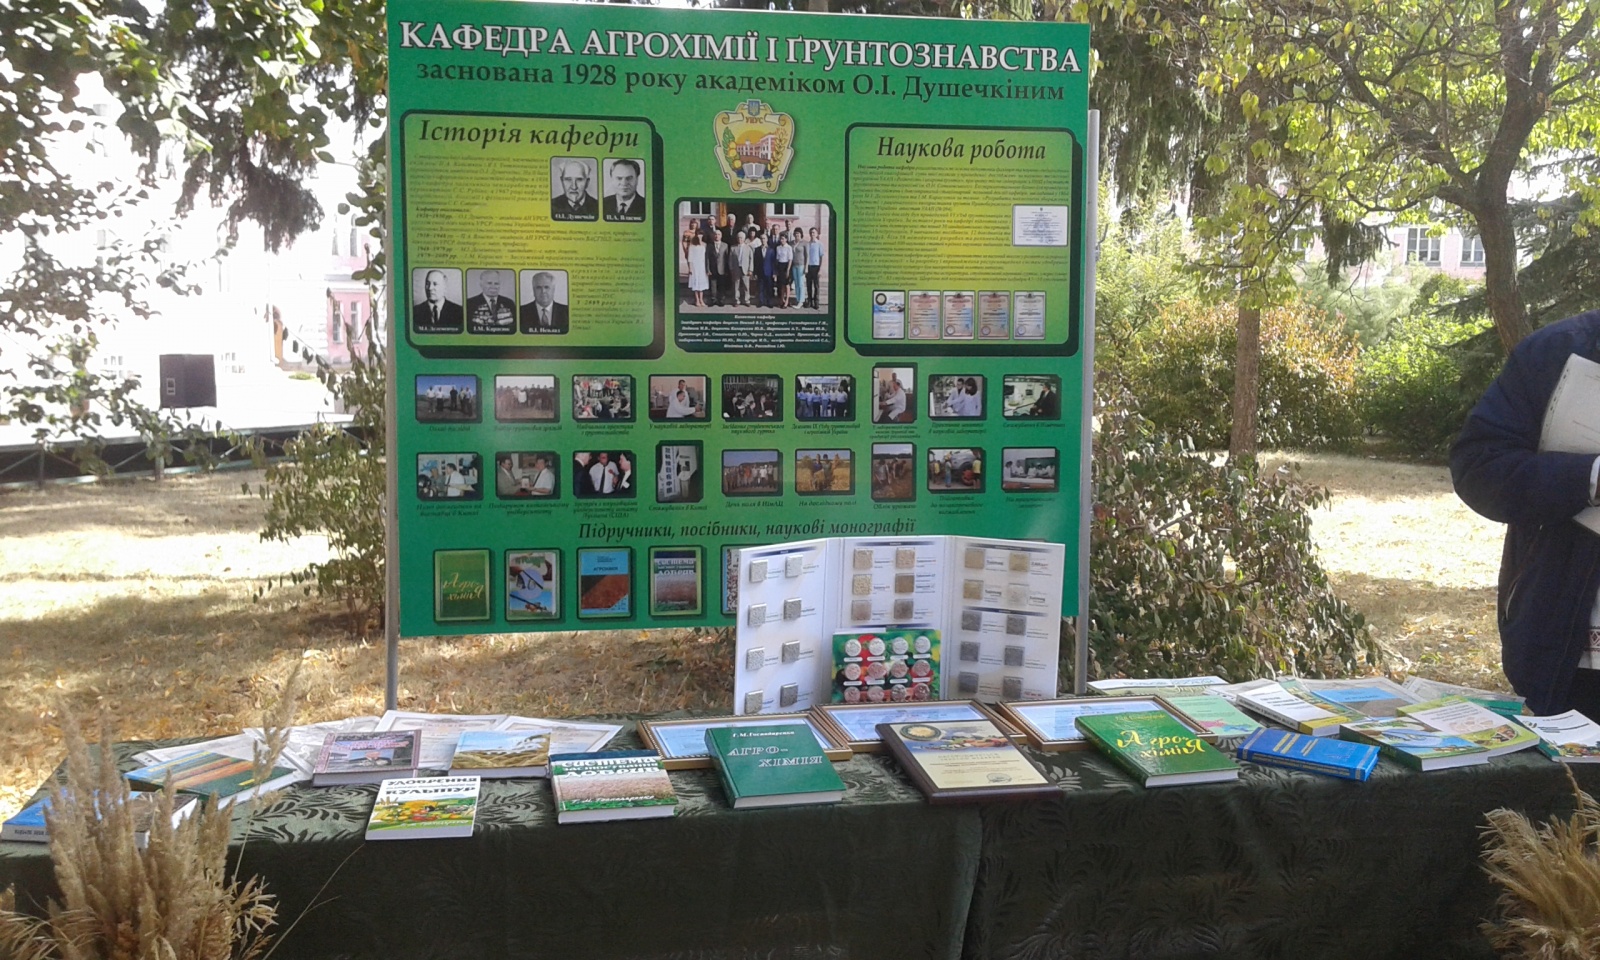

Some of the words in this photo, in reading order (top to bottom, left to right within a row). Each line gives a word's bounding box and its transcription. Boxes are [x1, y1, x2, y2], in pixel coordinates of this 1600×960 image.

[399, 22, 575, 58] КАФЕДРА
[580, 27, 759, 62] АГРОХІМІЇ
[765, 37, 778, 62] І
[785, 35, 1082, 73] ҐРУНТОЗНАВСТВА
[416, 62, 553, 84] заснована
[561, 64, 616, 86] 1928
[625, 70, 687, 94] року
[695, 72, 846, 95] академіком
[853, 74, 896, 96] О.І.
[903, 75, 1065, 103] Душечкіним
[418, 119, 522, 149] Історія
[530, 124, 639, 152] кафедри
[877, 136, 964, 164] Наукова
[969, 139, 1047, 164] робота
[578, 522, 675, 542] Підручники,
[680, 521, 762, 539] посібники,
[766, 520, 826, 540] наукові
[828, 518, 917, 538] монографії
[758, 755, 823, 767] ХІМІЯ
